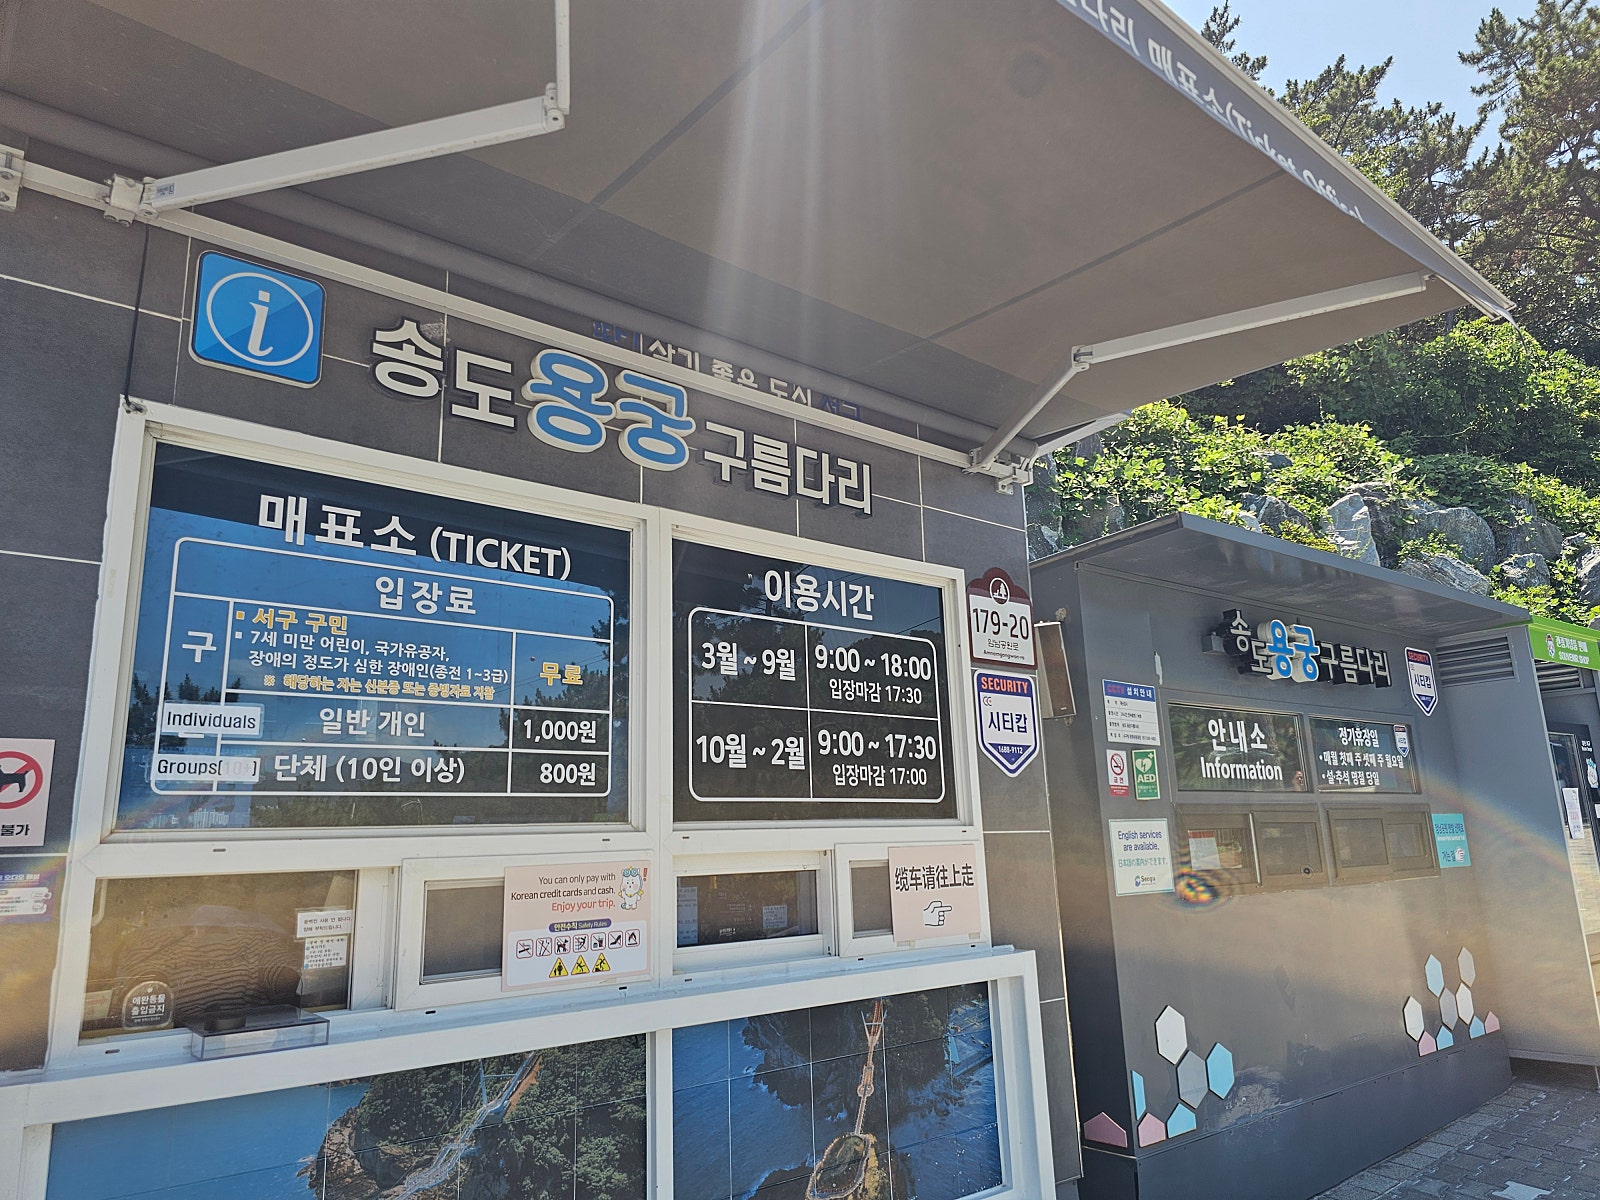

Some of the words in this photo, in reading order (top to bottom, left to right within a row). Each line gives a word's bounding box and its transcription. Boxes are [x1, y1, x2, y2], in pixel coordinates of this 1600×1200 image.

[258, 494, 417, 556] 매표소
[430, 526, 571, 581] (TICKET)
[375, 576, 477, 615] 입장료
[764, 569, 875, 621] 이용시간
[252, 607, 298, 631] 서구
[305, 612, 348, 635] 구민
[972, 607, 1029, 641] 179-20
[250, 630, 278, 648] 7세
[283, 632, 315, 650] 미만
[320, 636, 370, 656] 어린이,
[374, 640, 450, 662] 국가유공자,
[249, 650, 297, 669] 장애의
[302, 654, 349, 673] 정도가
[353, 658, 384, 675] 심한
[387, 660, 461, 681] 장애인(종전
[539, 661, 584, 686] 무료
[701, 640, 739, 676] 3월
[762, 648, 796, 682] 9월
[814, 644, 860, 673] 9:00
[880, 652, 932, 681] 18:00
[283, 673, 335, 692] 해당하는
[337, 677, 363, 693] 자는
[364, 678, 400, 695] 신분증
[402, 681, 426, 697] 또는
[428, 682, 472, 699] 증빙자료
[473, 685, 496, 701] 지참
[829, 678, 882, 703] 입장마감
[885, 685, 923, 705] 17:30
[980, 676, 1029, 694] SECURITY
[166, 710, 256, 729] Individuals
[319, 707, 371, 736] 일반
[377, 710, 426, 738] 개인
[523, 719, 597, 744] 1,000원
[988, 711, 1028, 734] 시티캅
[817, 729, 864, 757] 9:00
[884, 733, 937, 760] 17:30
[1207, 718, 1268, 753] 안내소
[1338, 727, 1380, 748] 정기휴장일
[695, 733, 747, 769] 10월
[770, 736, 806, 770] 2월
[1385, 754, 1405, 769] 월요일
[274, 754, 328, 783] 단체
[335, 755, 401, 784] (10인
[410, 756, 466, 785] 이상)
[539, 762, 597, 786] 800원
[832, 764, 885, 787] 입장마감
[889, 767, 927, 786] 17:00
[1137, 774, 1156, 783] AED
[1200, 756, 1283, 781] Information
[1351, 771, 1366, 786] 명절
[1366, 771, 1380, 786] 당일
[1, 823, 31, 837] 불가
[1117, 830, 1138, 841] English
[1139, 830, 1162, 839] services
[1123, 844, 1133, 852] are
[1133, 842, 1160, 851] available.
[538, 876, 553, 885] You
[554, 876, 568, 885] can
[569, 874, 585, 885] only
[586, 875, 600, 884] pay
[600, 872, 616, 882] with
[894, 862, 975, 893] 缆车请往上走
[510, 891, 539, 901] Korean
[539, 889, 561, 899] credit
[562, 887, 583, 898] cards
[583, 886, 597, 896] and
[597, 885, 616, 895] cash.
[551, 901, 576, 913] Enjoy
[576, 900, 597, 912] your
[598, 898, 616, 910] trip.
[578, 922, 594, 930] Safety
